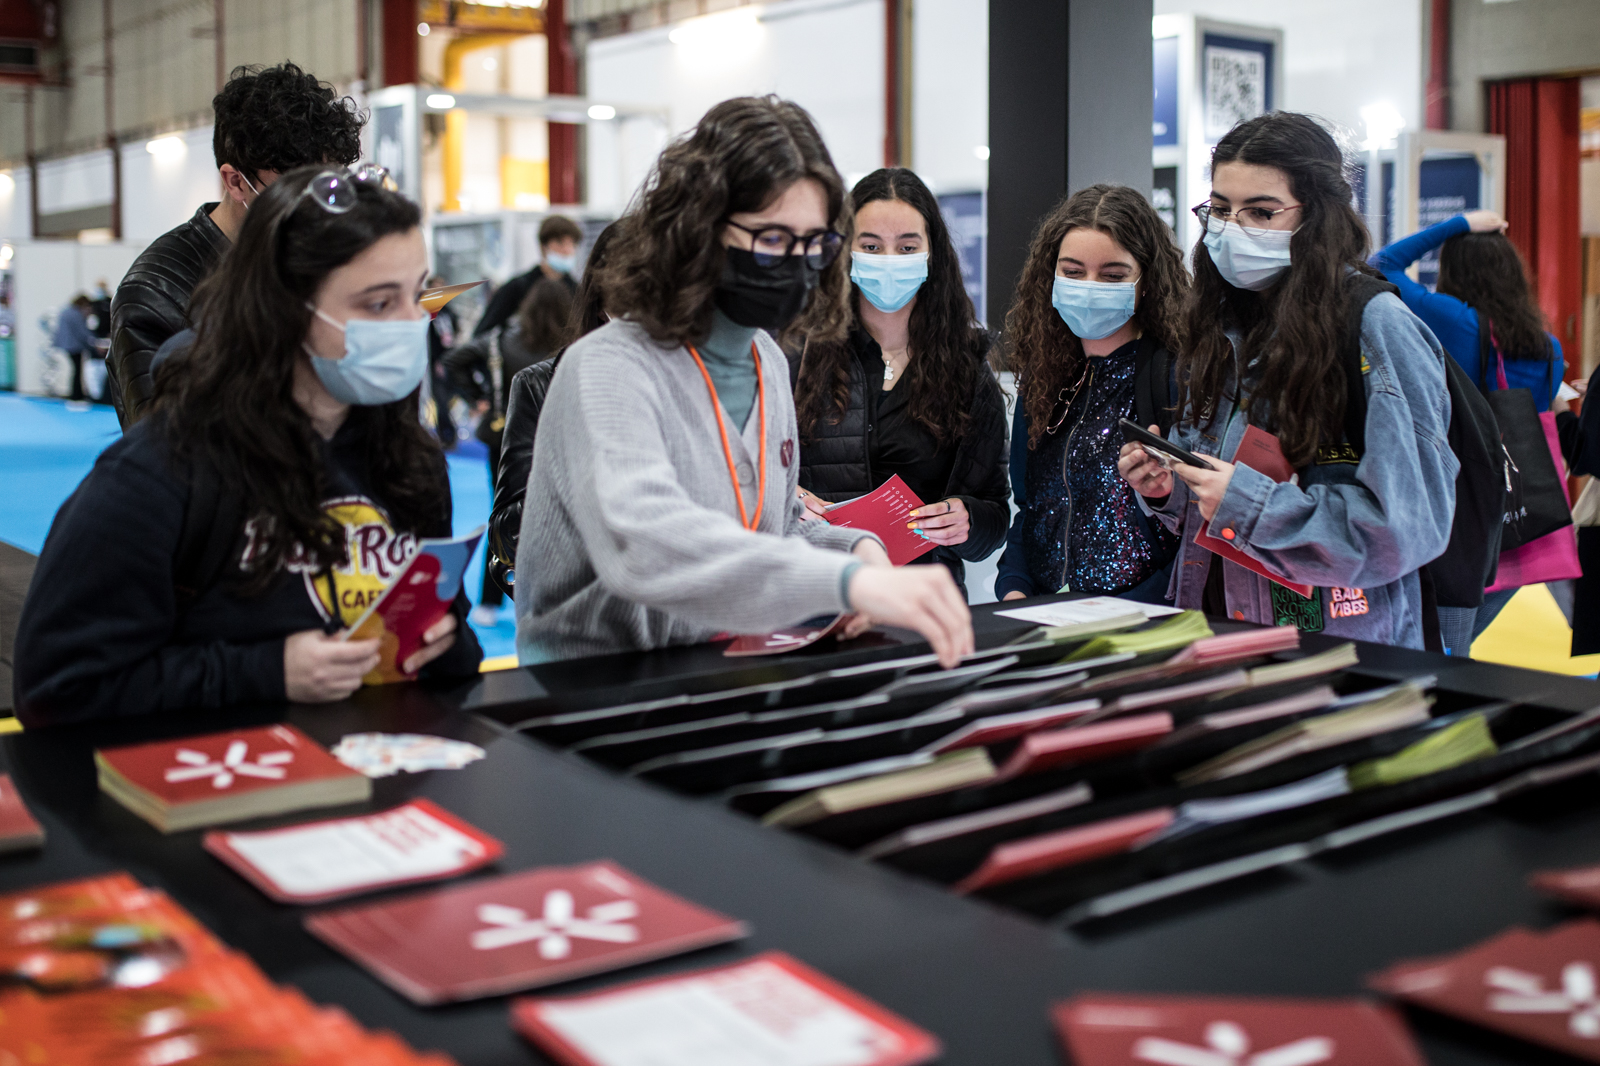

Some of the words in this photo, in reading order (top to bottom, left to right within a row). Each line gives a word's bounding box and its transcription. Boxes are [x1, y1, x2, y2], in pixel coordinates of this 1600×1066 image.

[351, 523, 418, 582] Ro
[341, 589, 383, 610] CAF
[1331, 587, 1363, 602] BAD
[1330, 599, 1368, 618] VIBES
